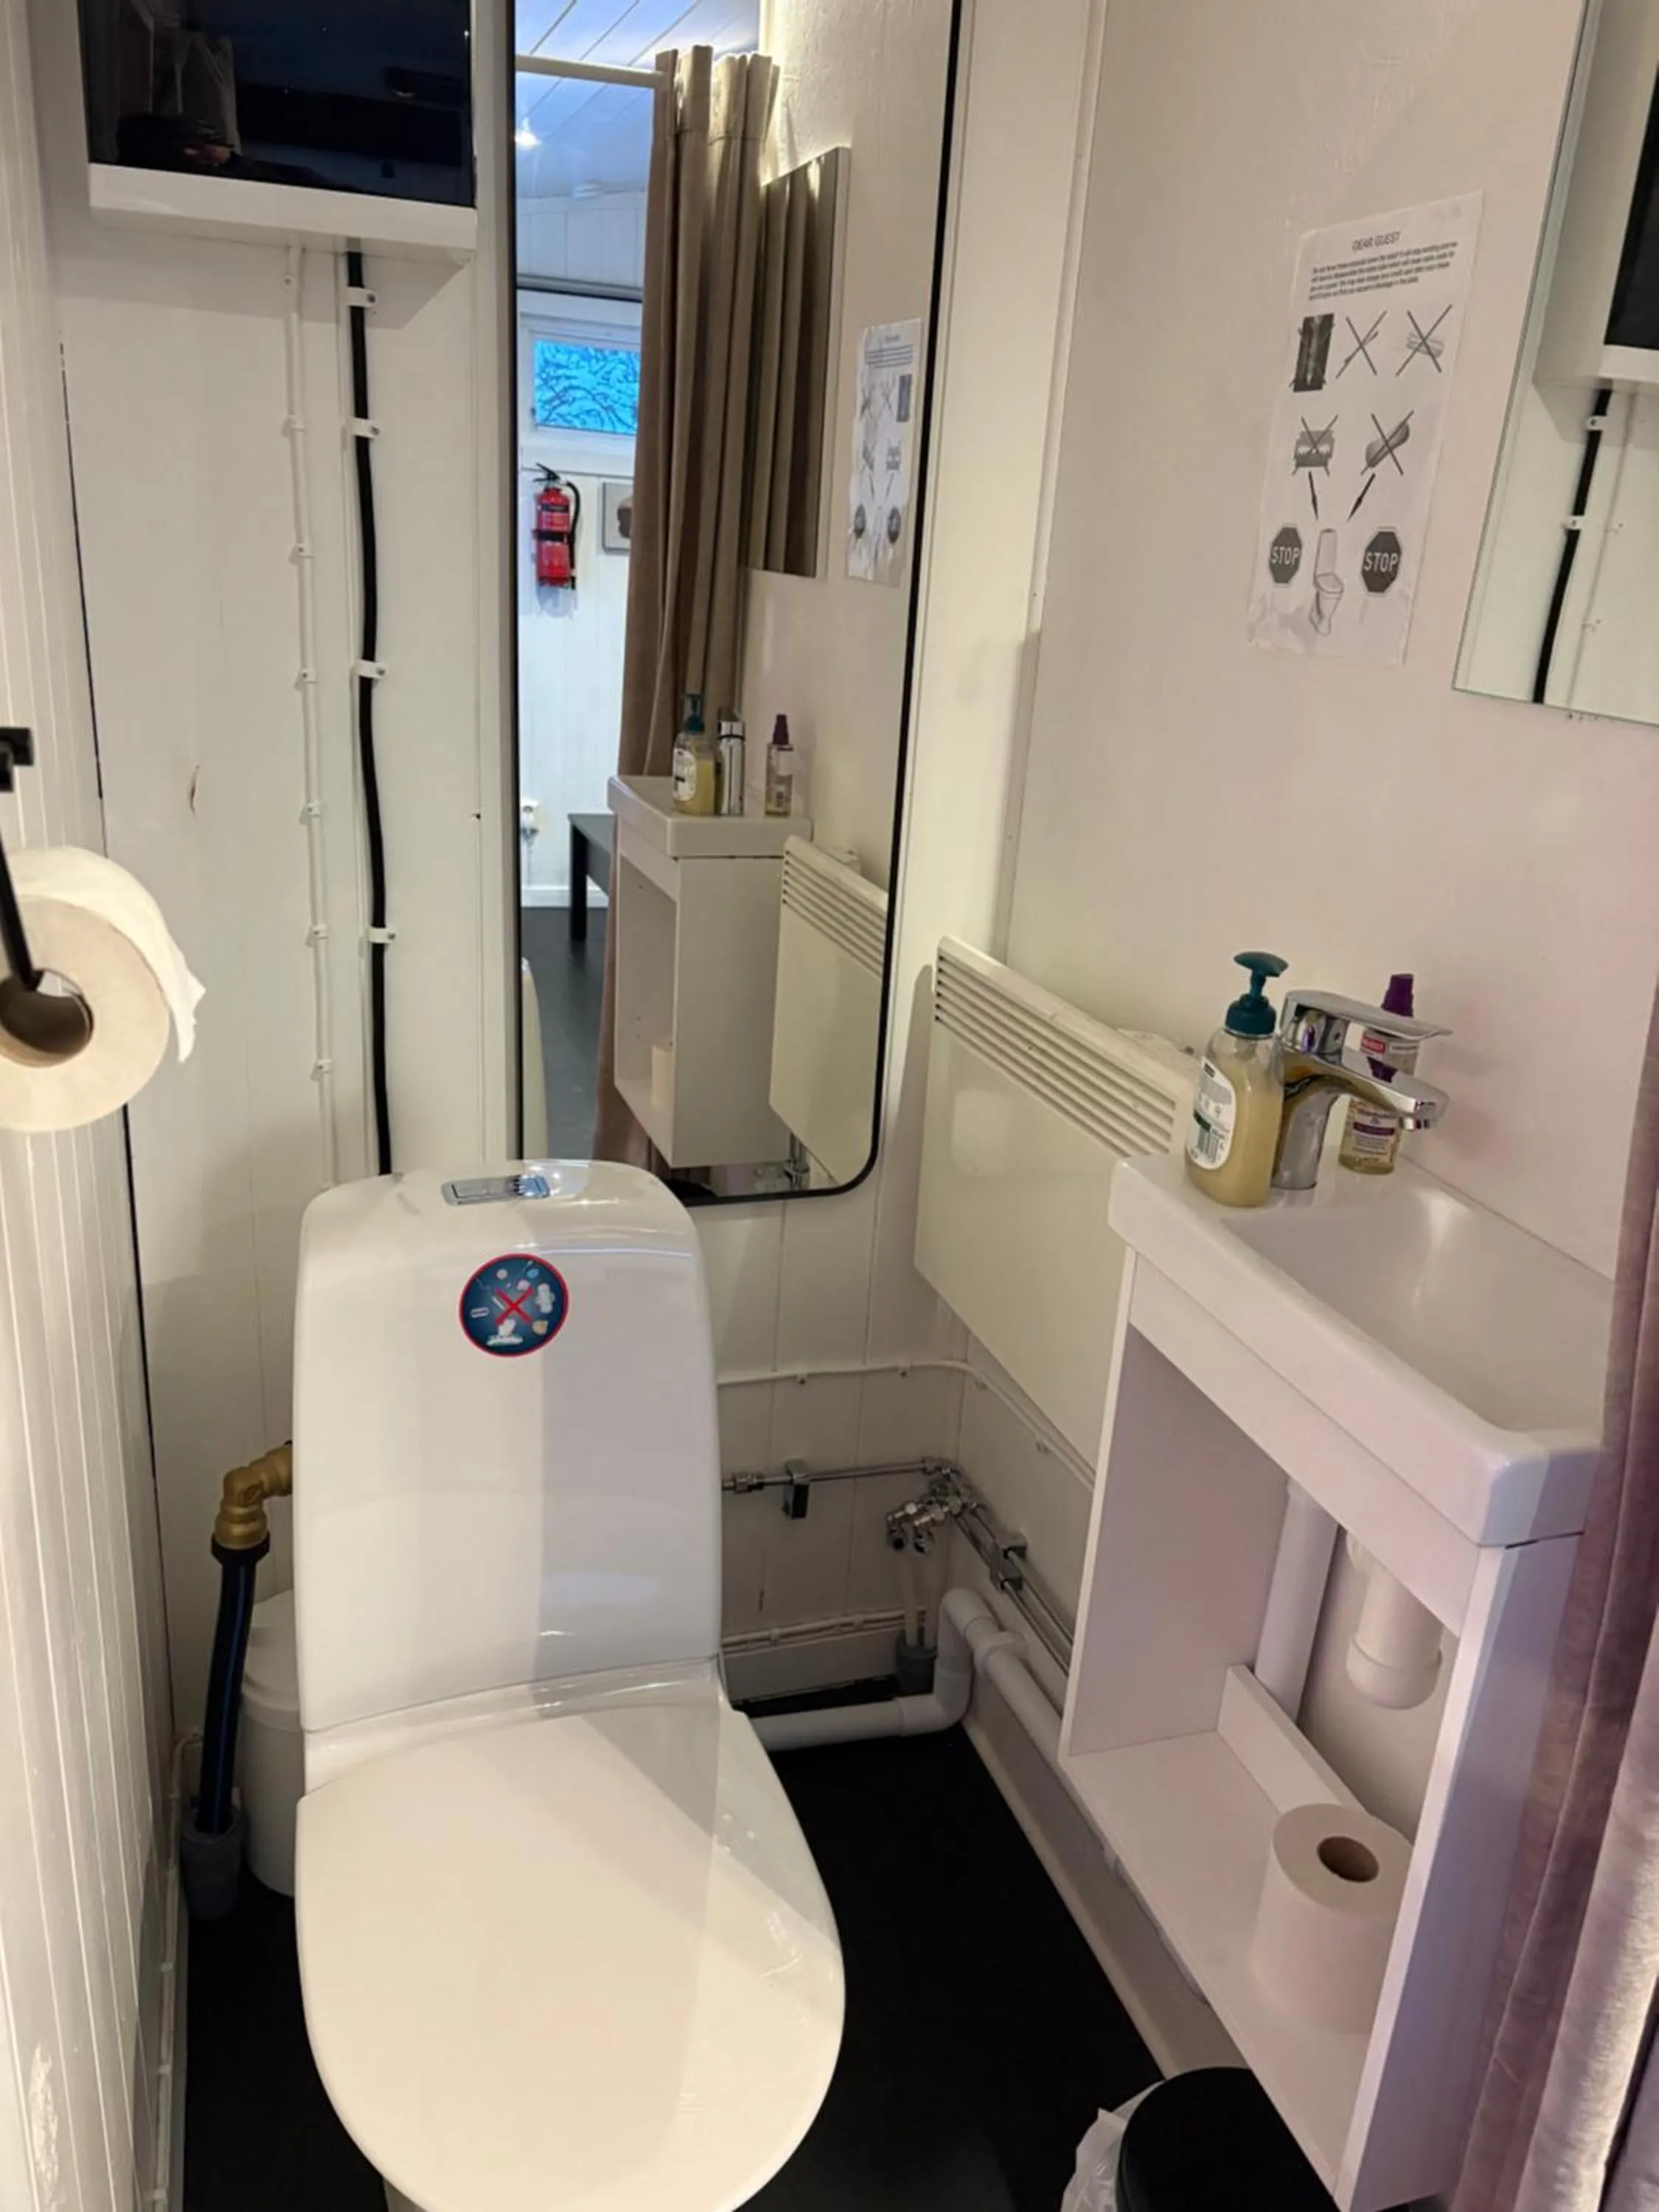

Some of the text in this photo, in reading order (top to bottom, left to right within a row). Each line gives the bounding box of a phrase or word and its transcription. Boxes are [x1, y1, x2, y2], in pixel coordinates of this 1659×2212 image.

[1352, 231, 1401, 252] DEAR GUEST
[1271, 546, 1299, 566] STOP
[1364, 552, 1399, 573] STOP
